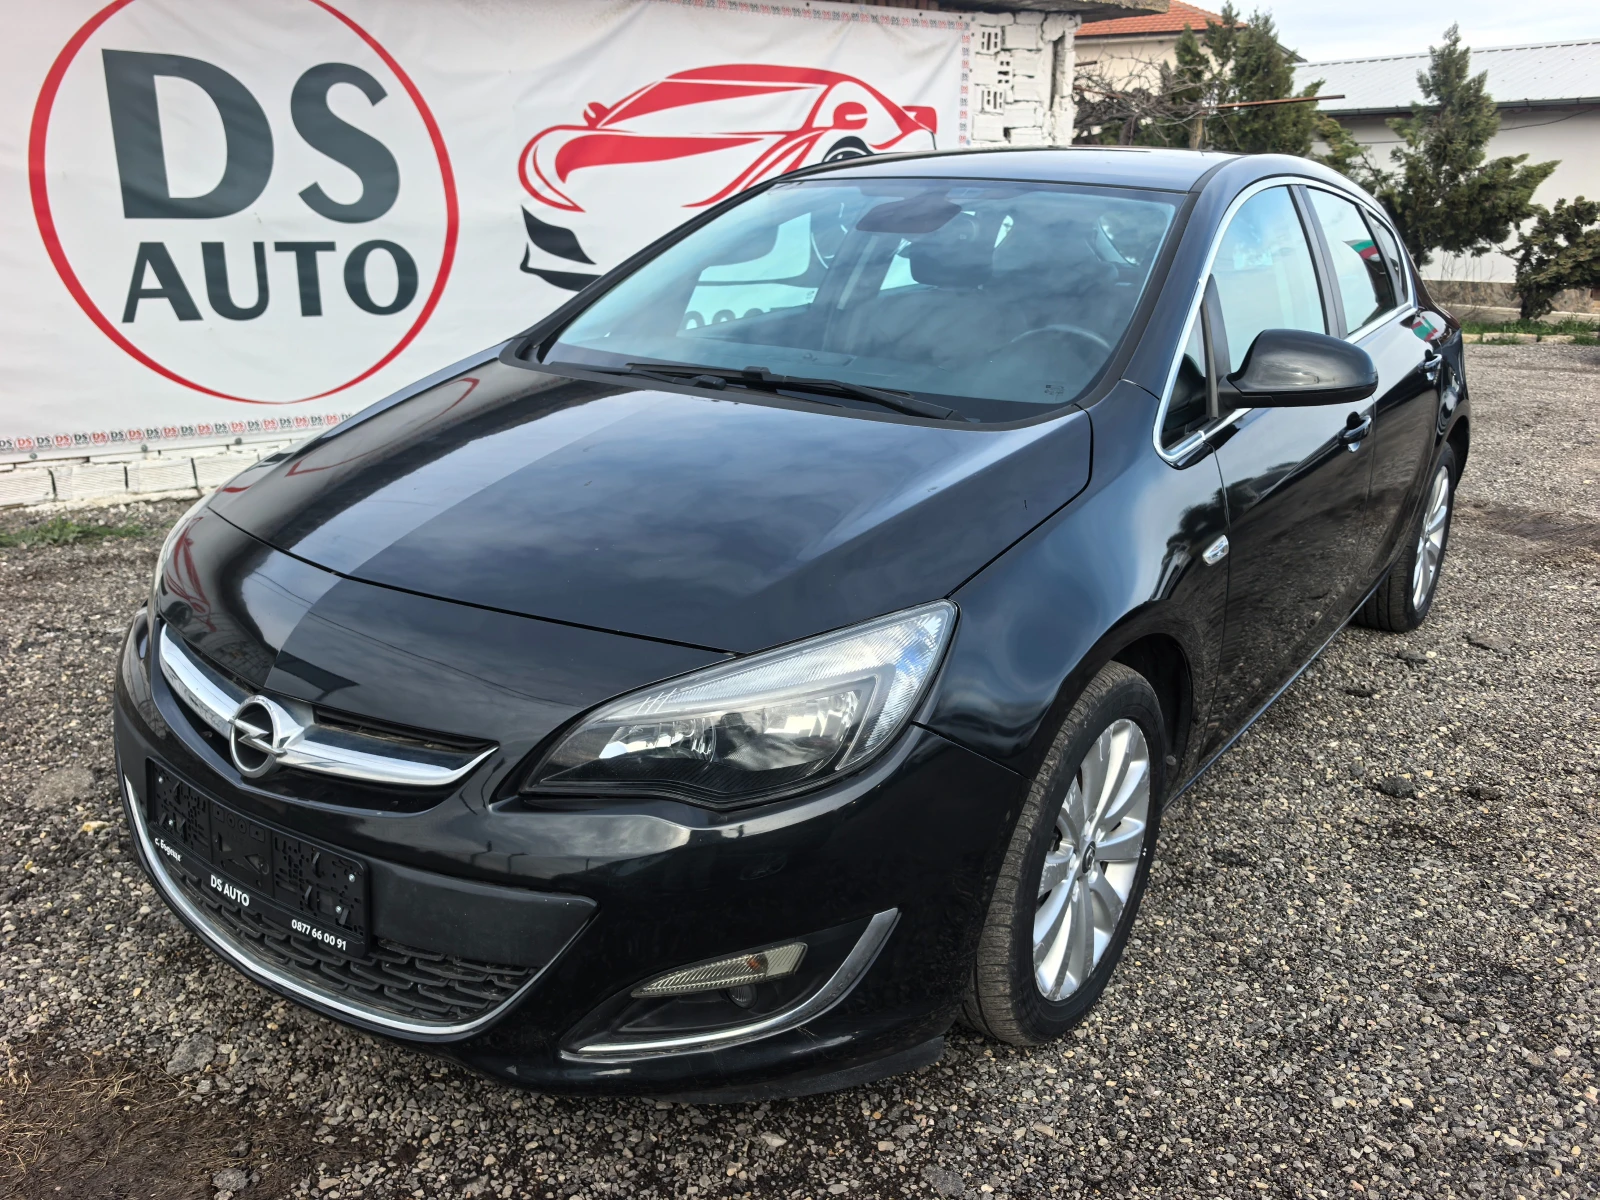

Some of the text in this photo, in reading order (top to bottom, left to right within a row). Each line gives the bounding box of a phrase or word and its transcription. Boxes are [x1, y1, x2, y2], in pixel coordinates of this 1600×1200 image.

[101, 48, 401, 224] DS
[122, 240, 419, 323] AUTO
[210, 874, 250, 906] DS AUTO
[292, 919, 346, 950] 0877 66 00 91
